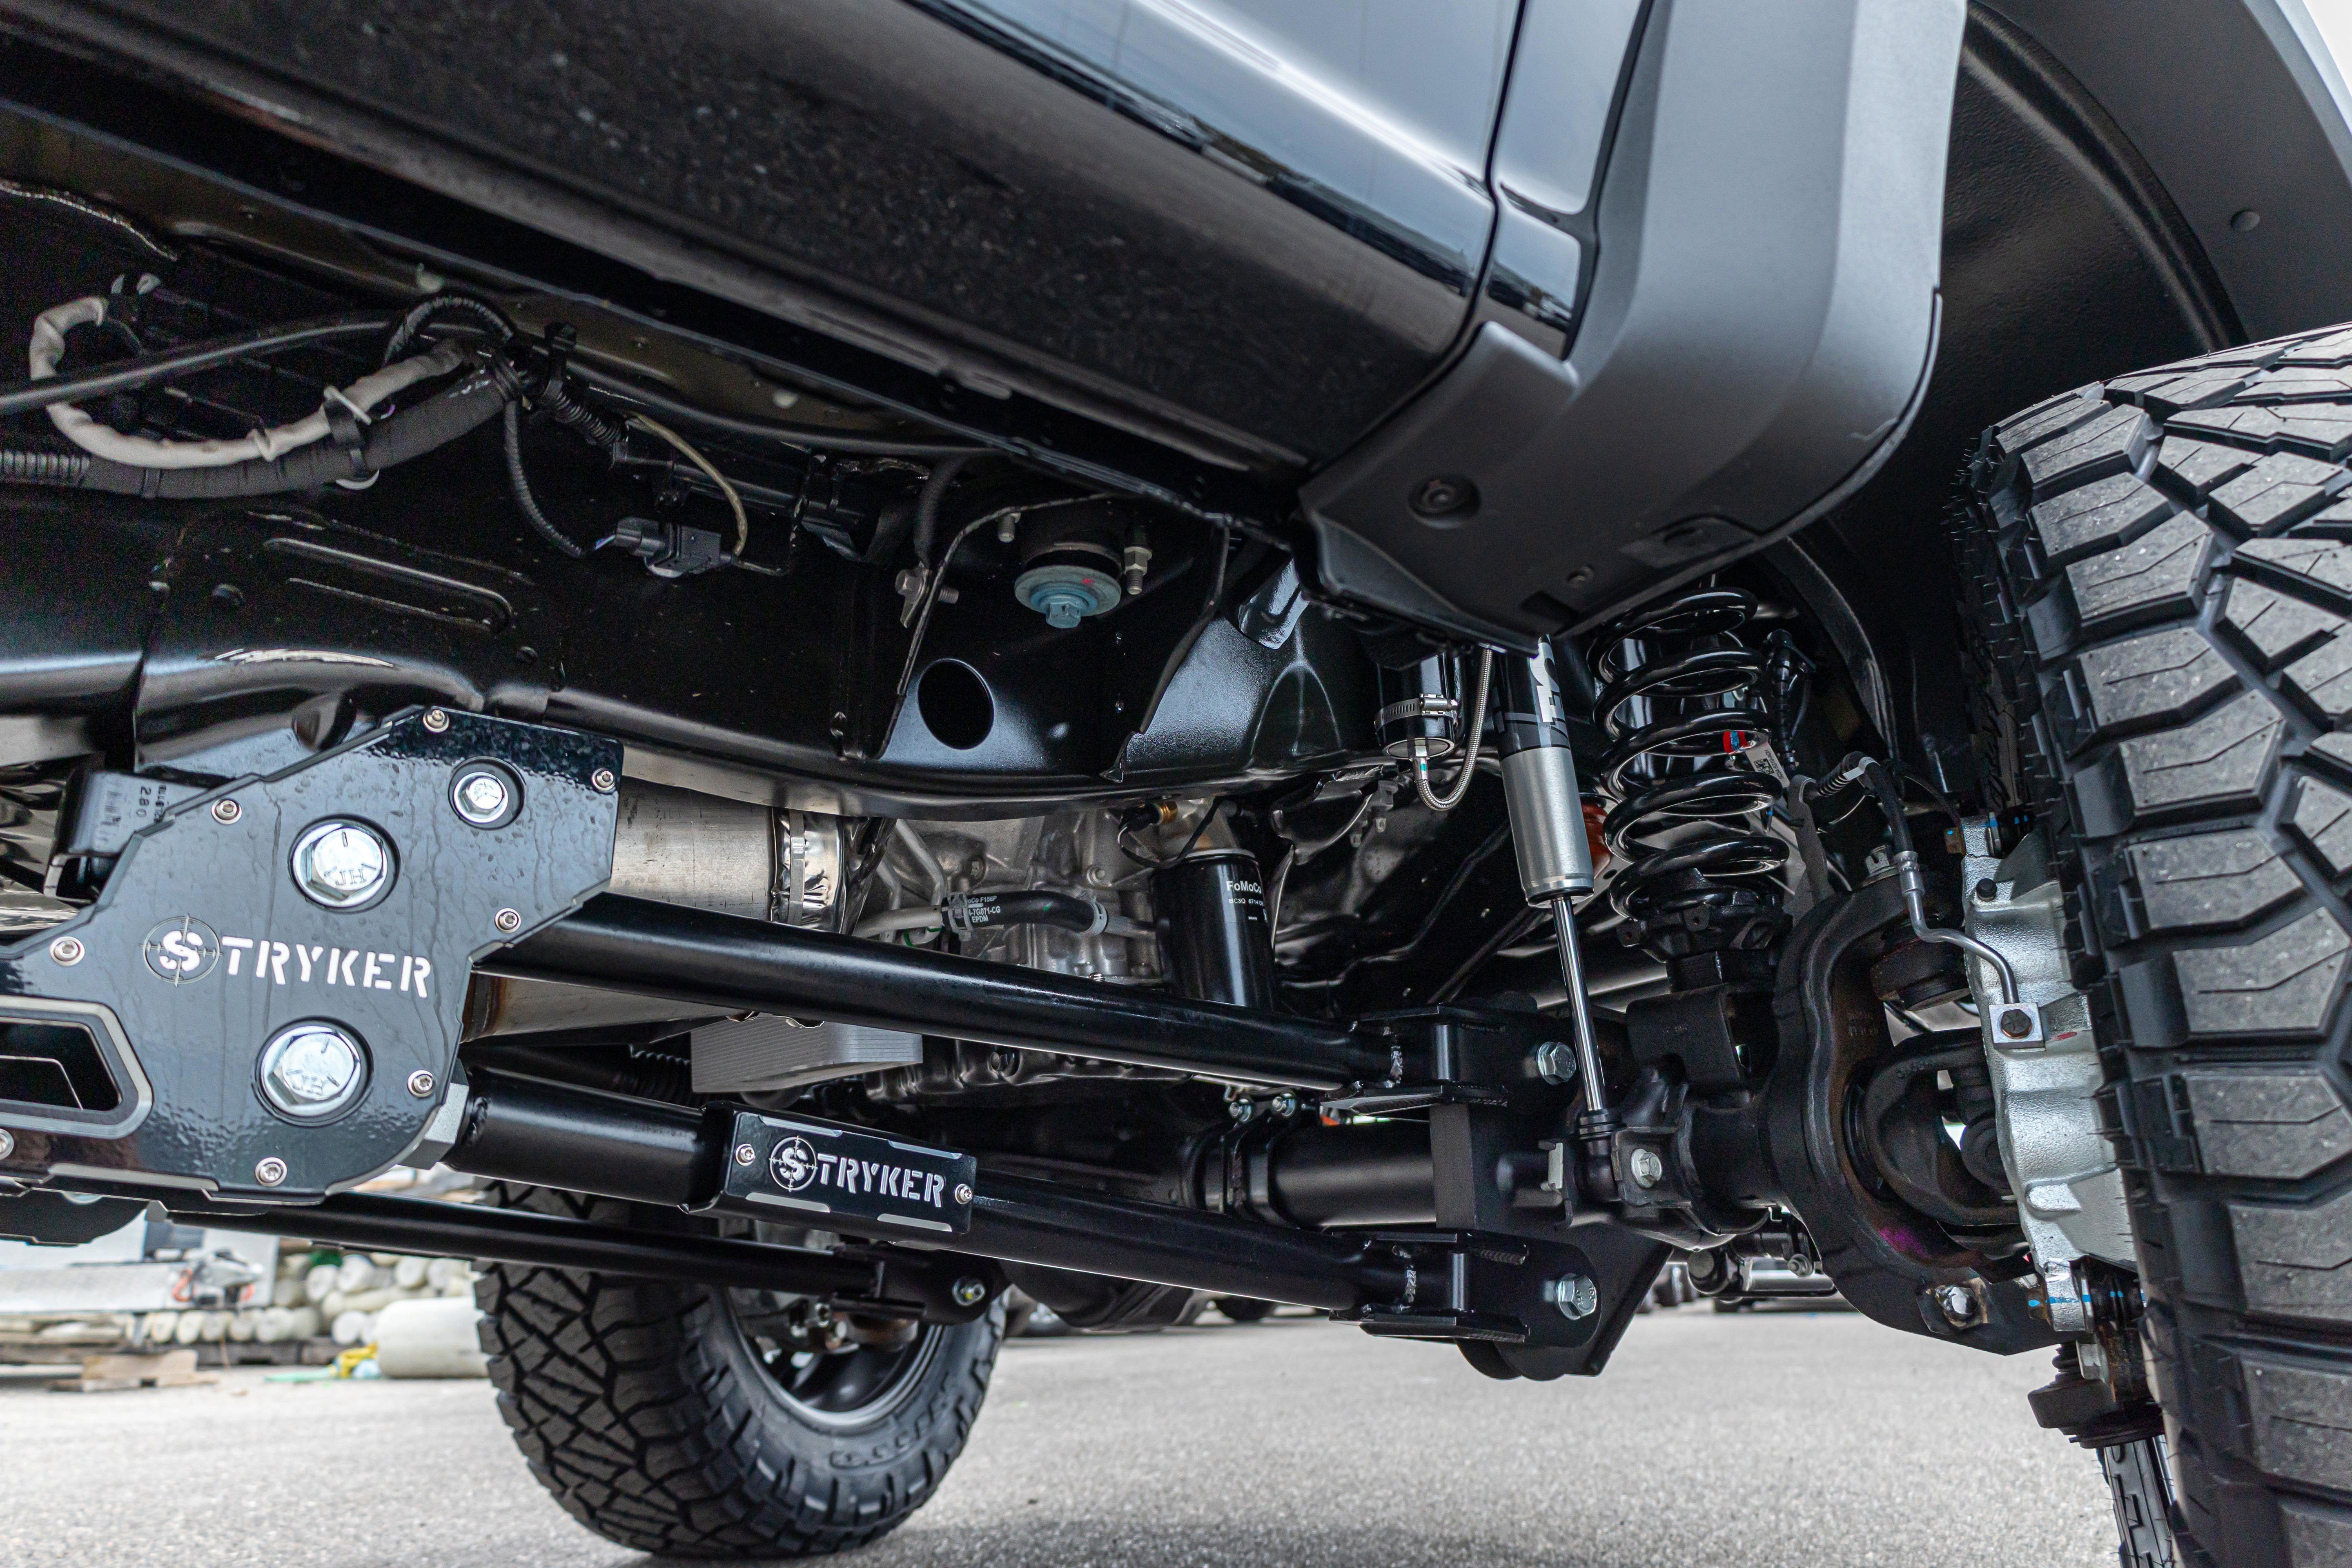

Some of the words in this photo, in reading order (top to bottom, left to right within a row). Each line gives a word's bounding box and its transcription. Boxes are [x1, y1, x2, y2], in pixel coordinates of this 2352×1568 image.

[136, 786, 151, 817] 280
[1226, 880, 1262, 894] FoMoCo
[971, 915, 989, 923] EPDM
[159, 930, 431, 998] STRYKER
[779, 1147, 945, 1208] STRYKER
